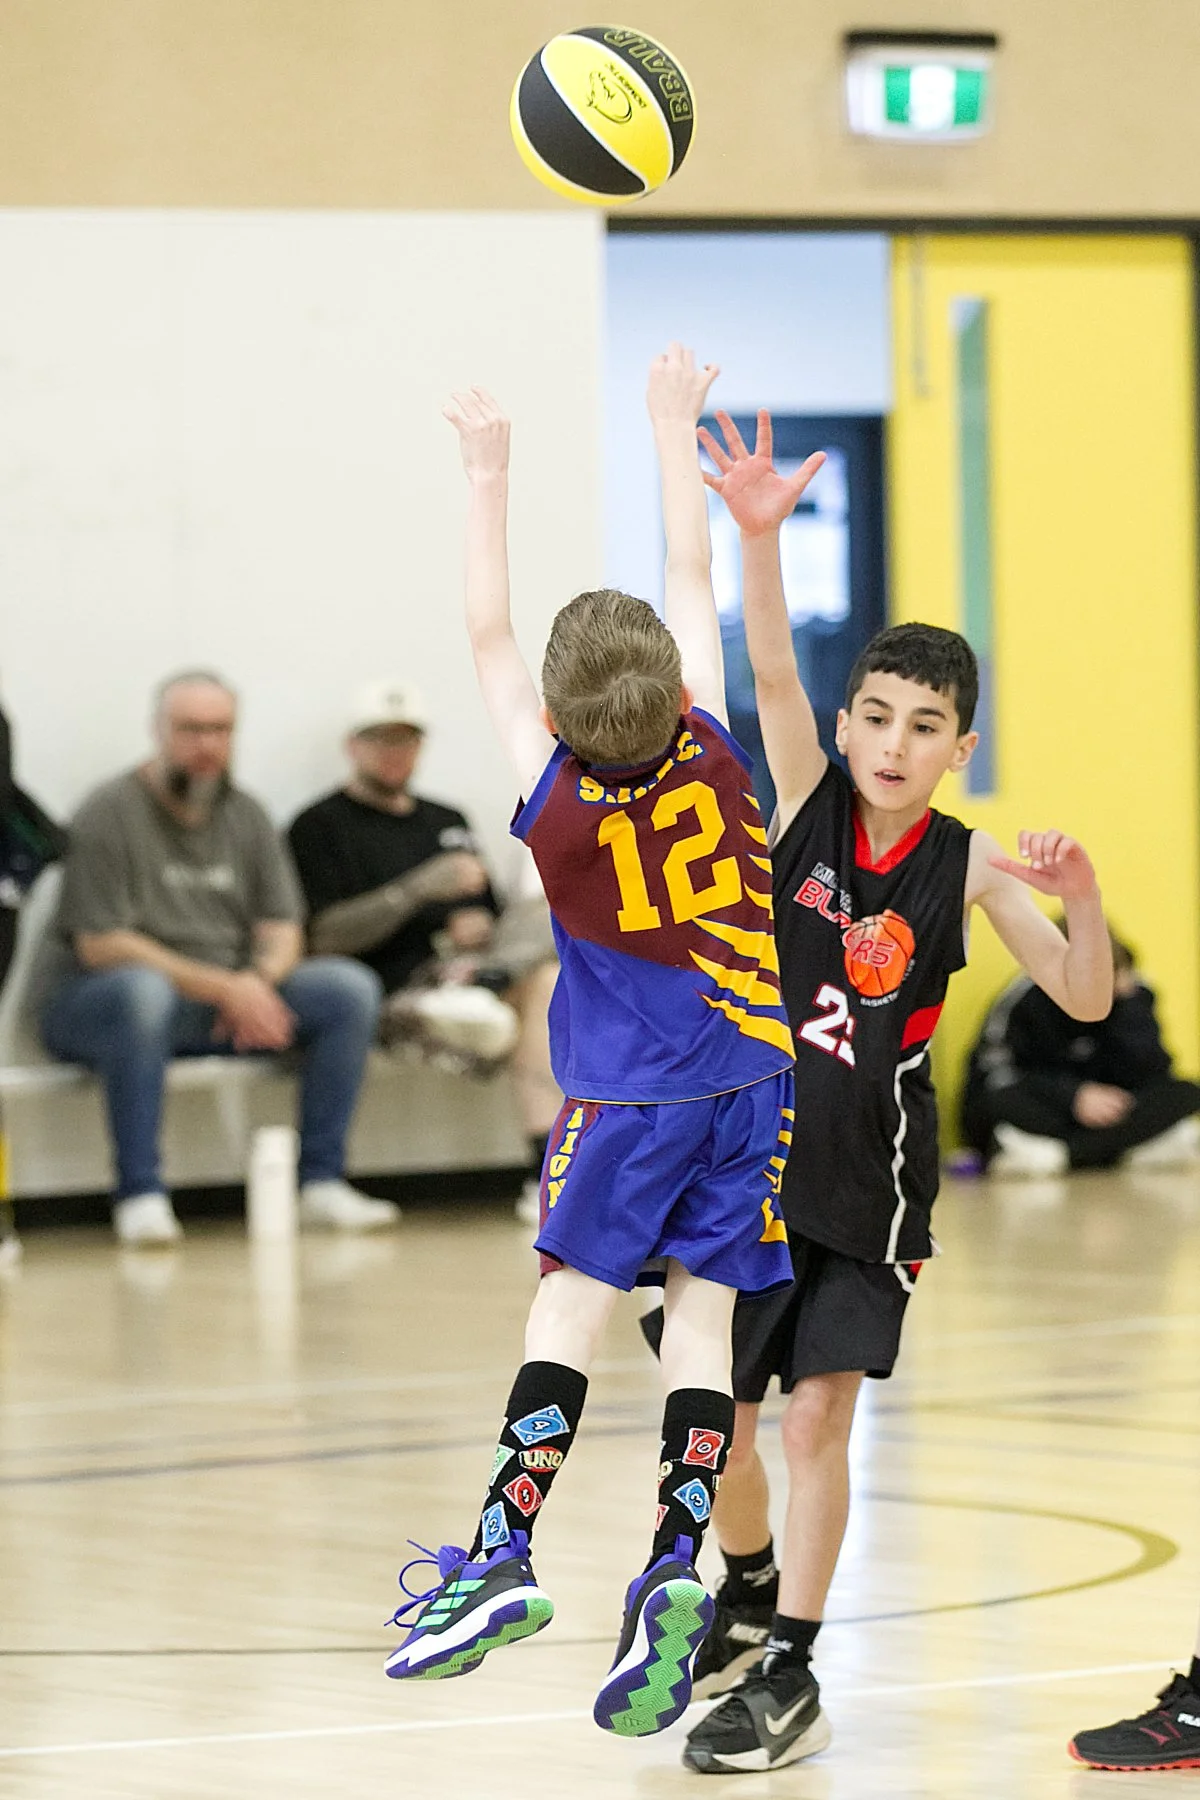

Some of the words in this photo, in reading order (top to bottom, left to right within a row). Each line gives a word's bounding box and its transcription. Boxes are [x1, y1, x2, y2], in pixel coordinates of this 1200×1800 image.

[597, 780, 743, 933] 12
[519, 1448, 564, 1471] UNO
[690, 1492, 703, 1507] 3
[488, 1516, 500, 1535] 2
